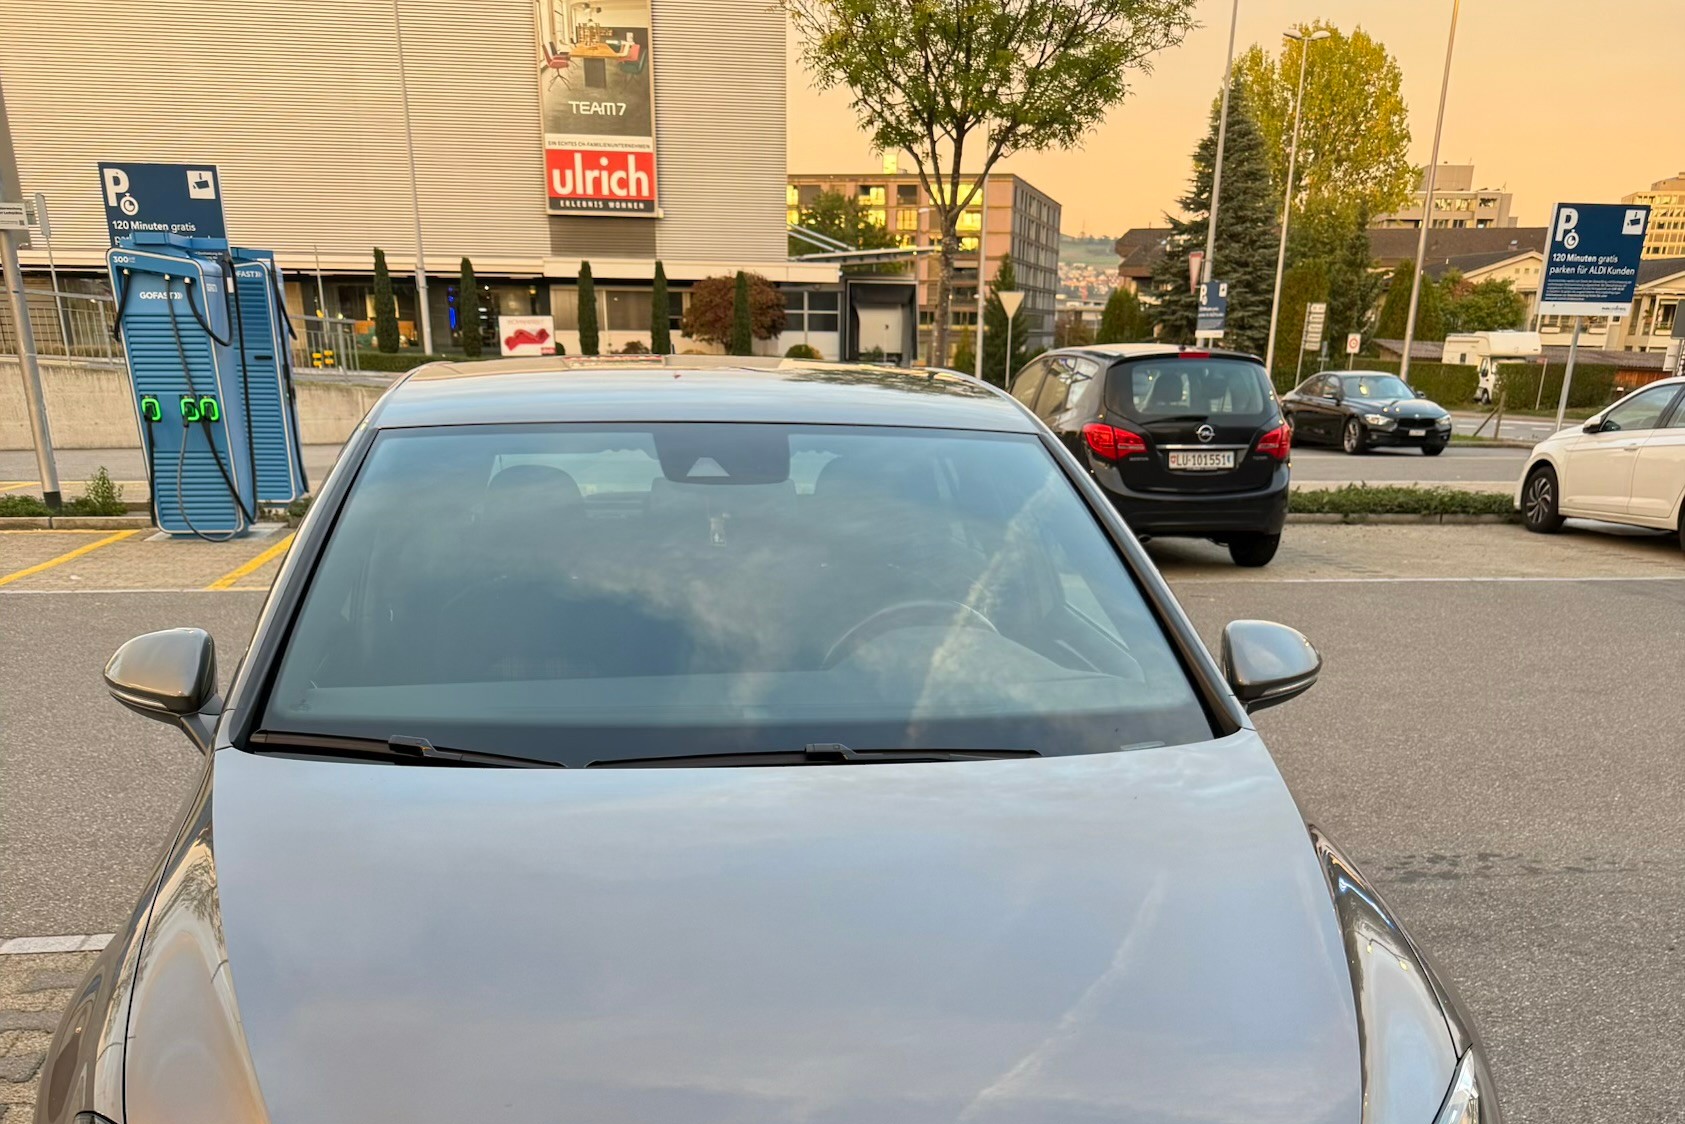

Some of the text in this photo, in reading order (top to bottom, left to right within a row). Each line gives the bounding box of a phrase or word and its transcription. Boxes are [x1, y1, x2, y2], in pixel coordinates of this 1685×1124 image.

[552, 152, 650, 197] ulrich
[103, 168, 130, 207] P
[560, 200, 603, 208] ERLEBNIS
[112, 220, 196, 234] 120 Minuten gratis
[1555, 208, 1579, 241] P
[1552, 253, 1618, 265] 120 Minuten gratis
[1549, 265, 1636, 276] parken für ALDI Kunden
